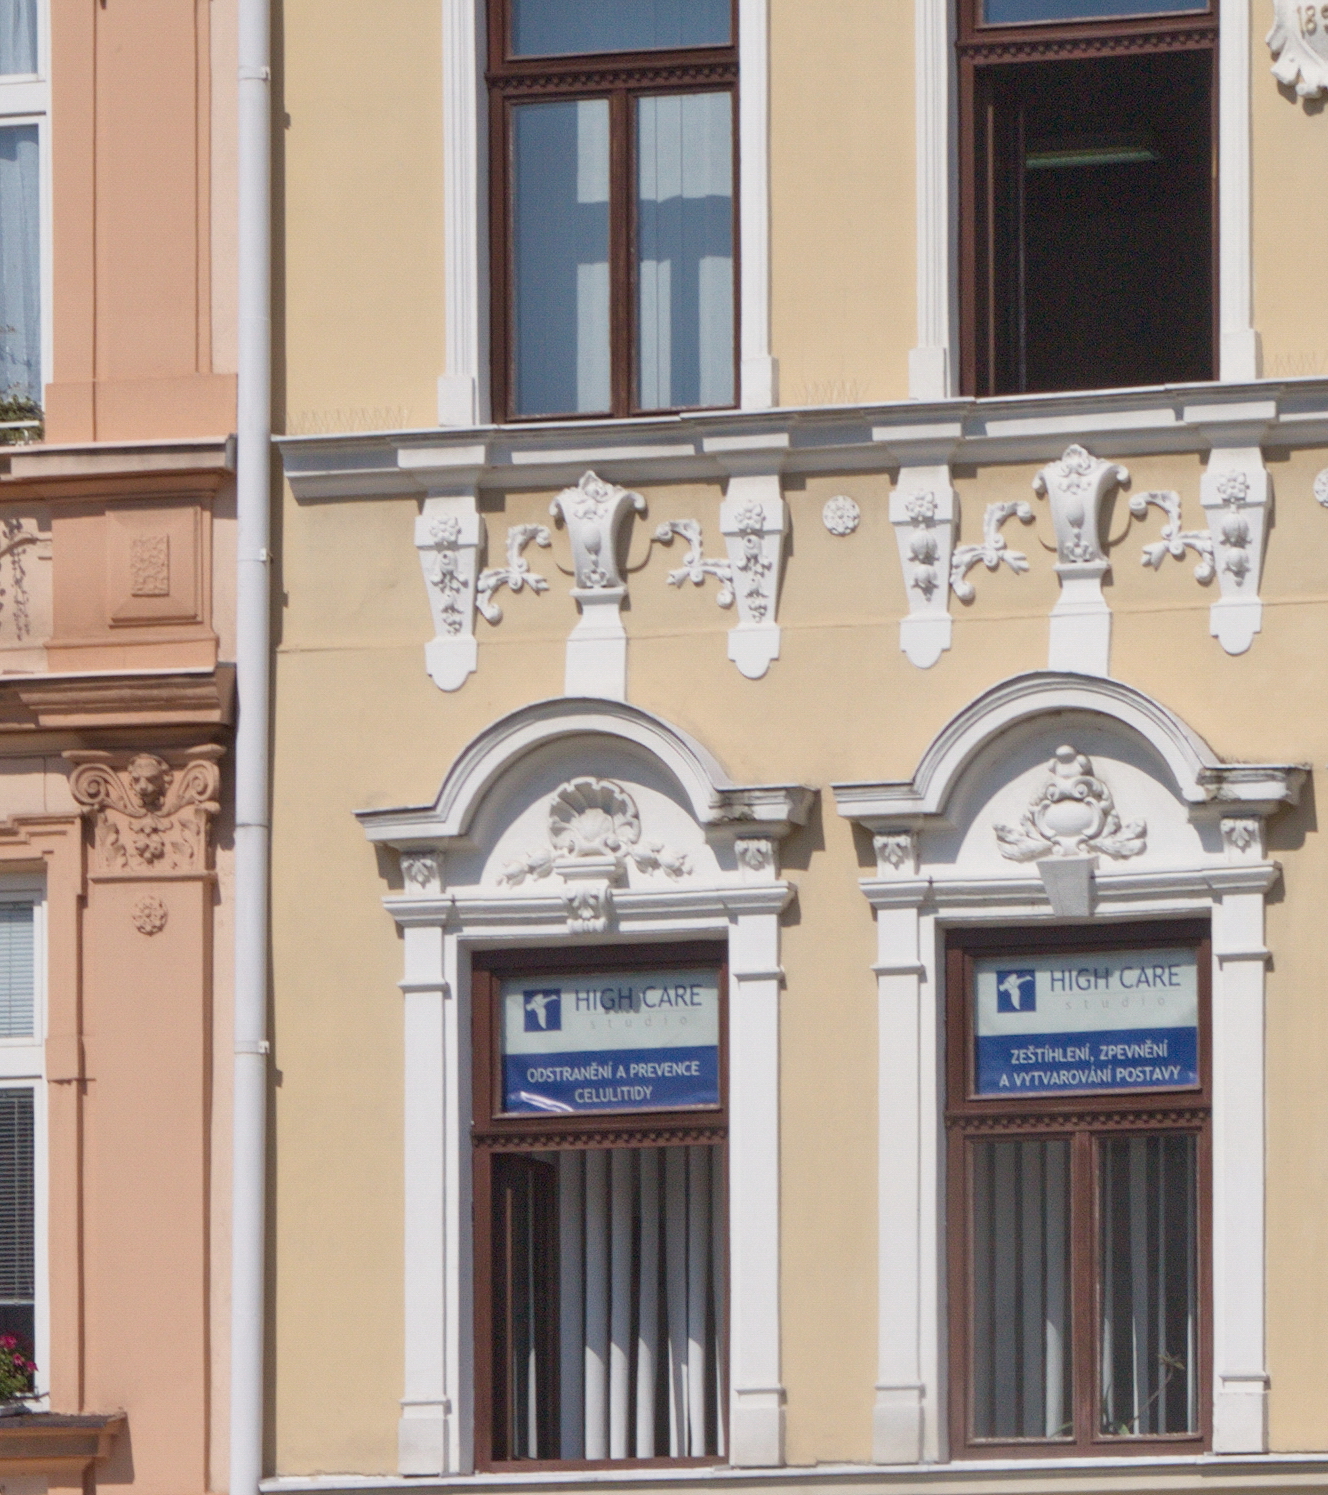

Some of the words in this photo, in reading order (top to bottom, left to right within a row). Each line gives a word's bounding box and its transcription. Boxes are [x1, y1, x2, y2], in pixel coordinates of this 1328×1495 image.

[1050, 967, 1109, 992] HIGH
[1120, 964, 1181, 989] CARE
[574, 987, 633, 1011] HIGH
[643, 984, 703, 1008] CARE
[1066, 996, 1165, 1010] studio
[590, 1016, 687, 1029] studio
[1011, 1044, 1095, 1064] ZEŠTÍHLENÍ,
[1100, 1039, 1168, 1060] ZPEVNĚNÍ
[527, 1062, 612, 1083] ODSTRANĚNÍ
[616, 1066, 626, 1079] A
[630, 1061, 700, 1077] PREVENCE
[999, 1074, 1010, 1087] A
[1013, 1066, 1112, 1086] VYTVAROVÁNÍ
[1117, 1066, 1181, 1082] POSTAVY
[574, 1086, 653, 1103] CELULITIDY
